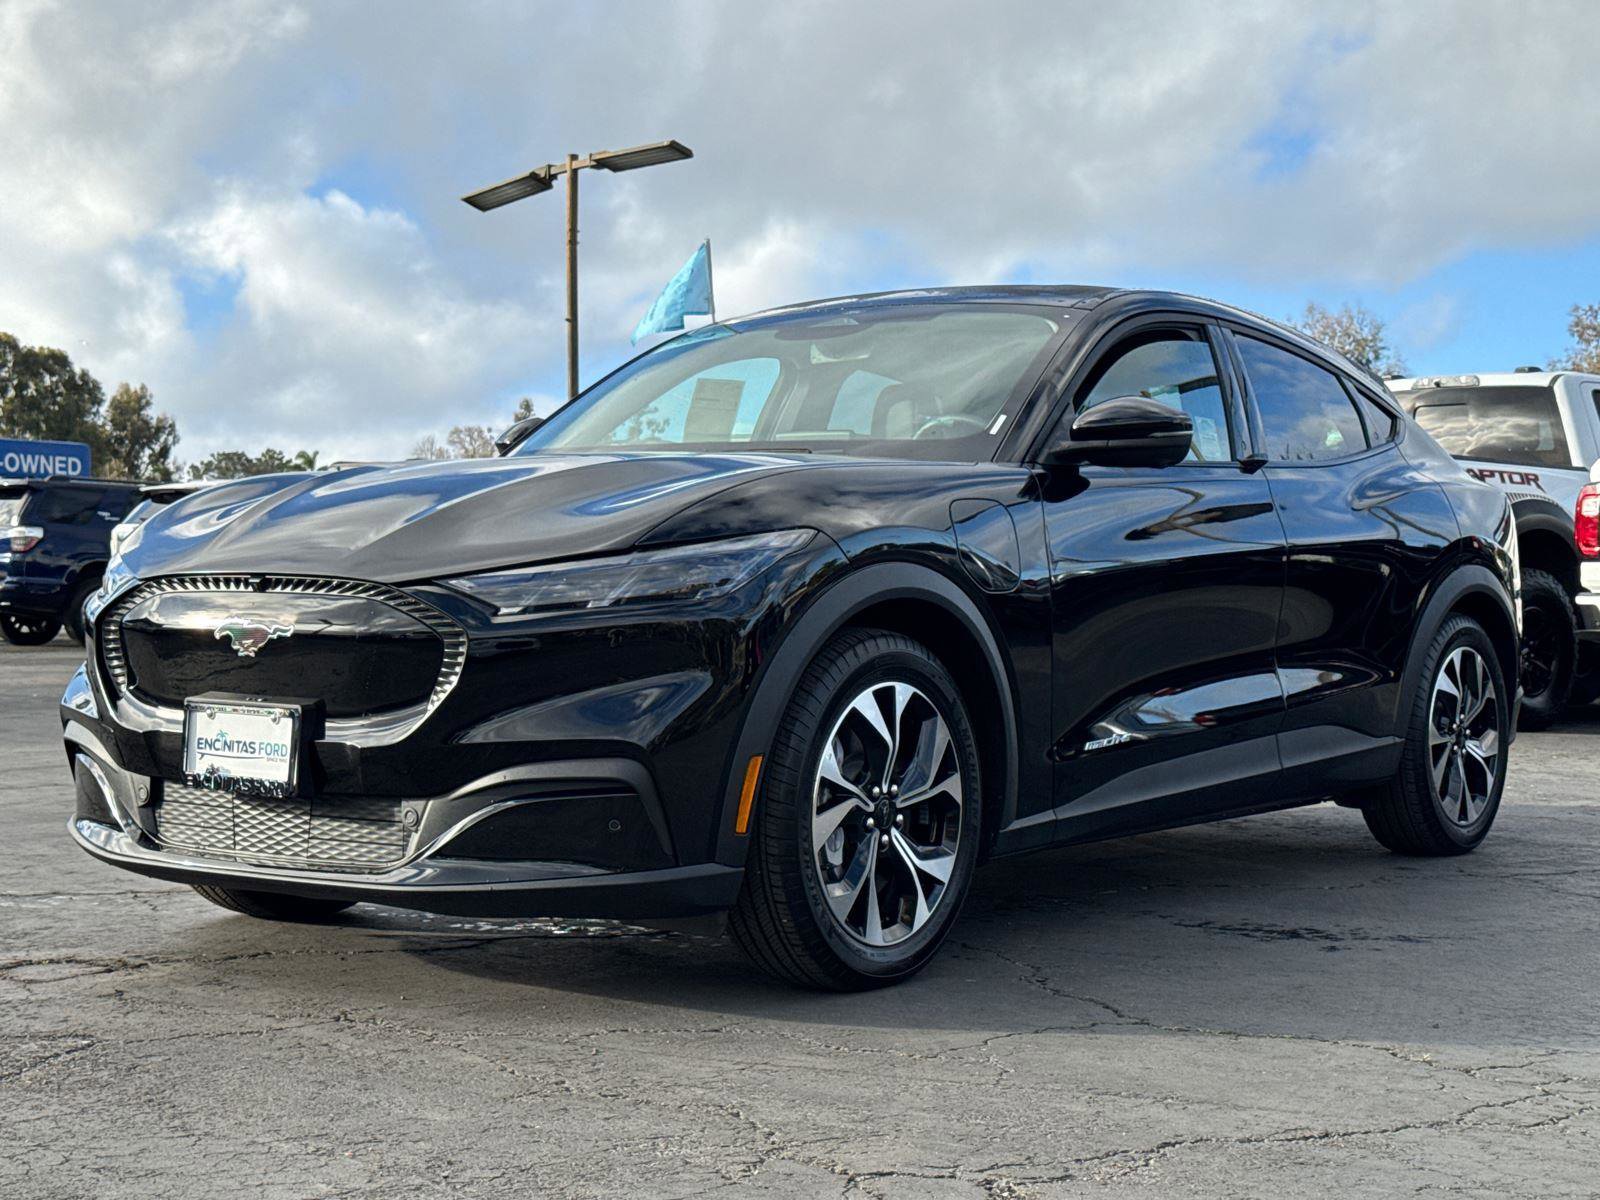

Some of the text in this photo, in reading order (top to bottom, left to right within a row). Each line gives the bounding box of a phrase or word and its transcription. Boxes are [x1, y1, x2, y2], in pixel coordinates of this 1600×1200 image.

[1465, 468, 1547, 494] APTOR
[197, 734, 288, 757] ENCINITAS FORD
